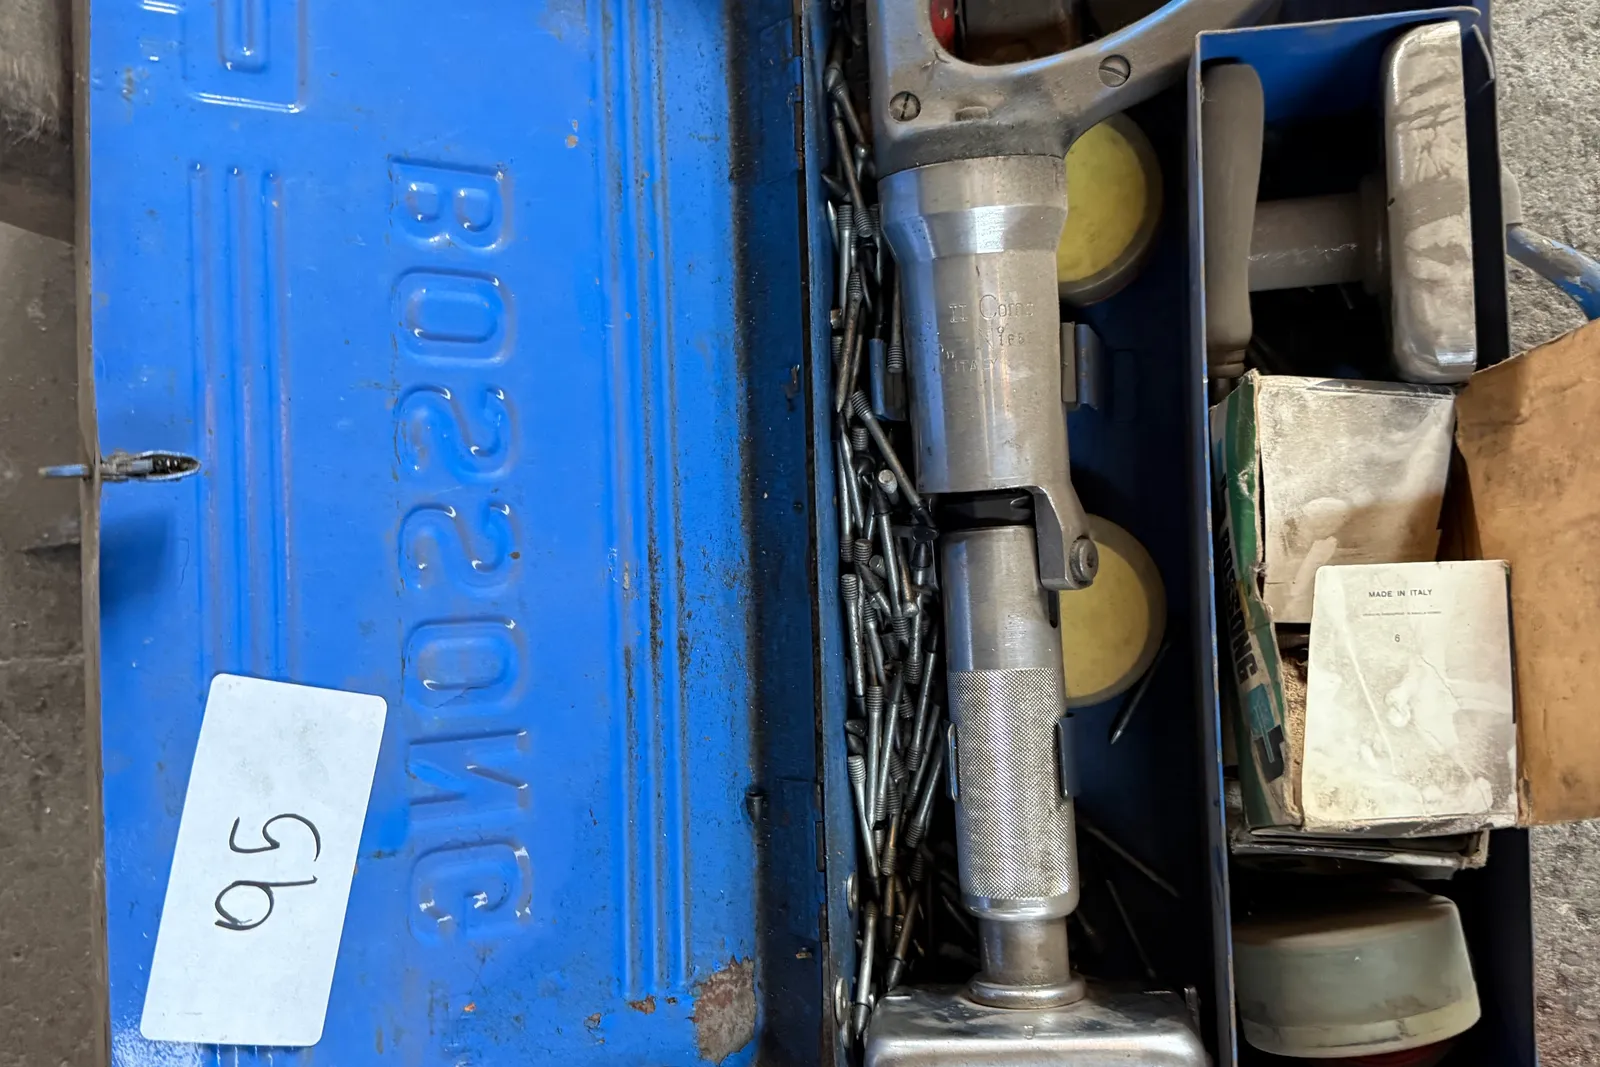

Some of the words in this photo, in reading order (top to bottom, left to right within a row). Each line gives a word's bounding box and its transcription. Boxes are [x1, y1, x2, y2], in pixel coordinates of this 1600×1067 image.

[1368, 590, 1393, 598] MADE
[1397, 589, 1406, 597] IN
[1410, 588, 1433, 596] ITALY
[1394, 633, 1401, 643] 6
[214, 812, 322, 931] 95
